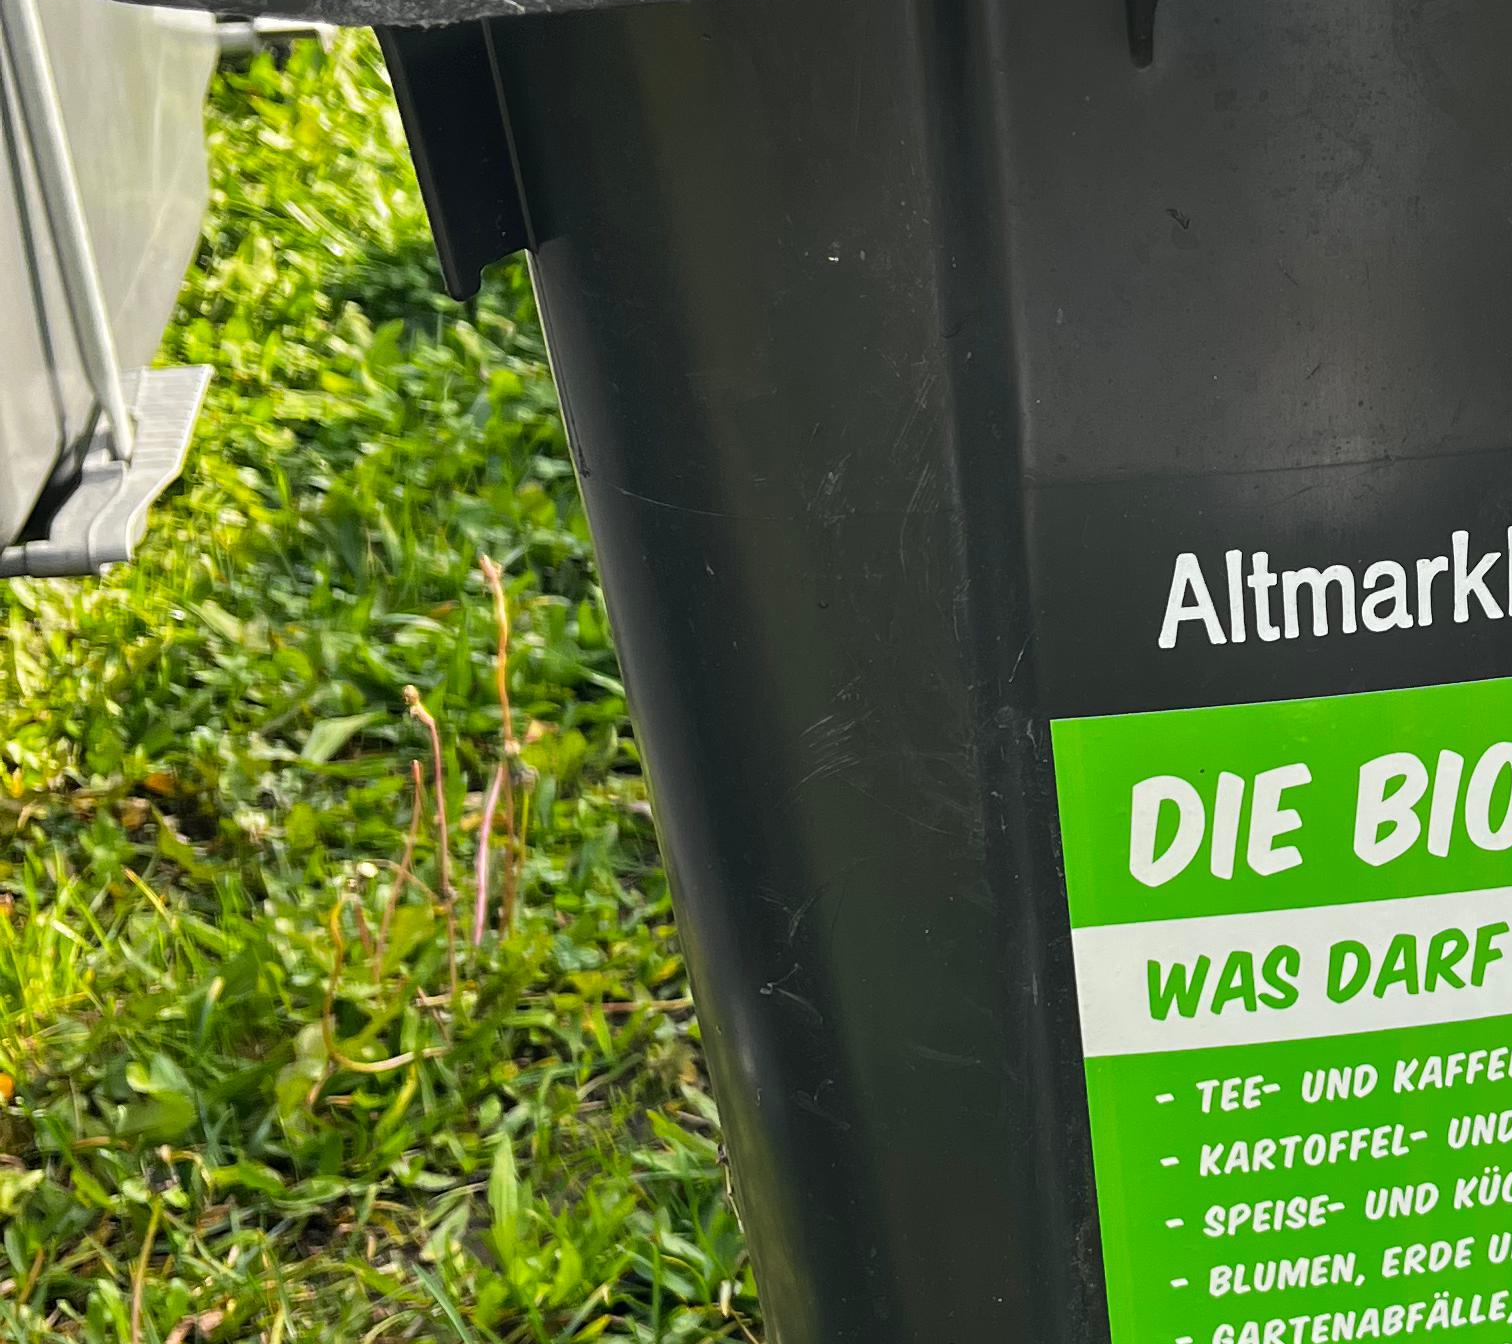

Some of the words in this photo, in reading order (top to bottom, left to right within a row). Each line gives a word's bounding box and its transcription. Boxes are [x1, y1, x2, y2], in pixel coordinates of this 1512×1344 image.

[1130, 763, 1312, 887] DIE
[1147, 945, 1300, 1021] WAS
[1326, 920, 1505, 998] DARF
[1196, 1076, 1280, 1113] TEE-
[1302, 1064, 1377, 1103] UND
[1200, 1124, 1427, 1176] KARTOFFEL-
[1204, 1195, 1344, 1237] SPEISE-
[1366, 1183, 1438, 1220] UND
[1210, 1253, 1365, 1296] BLUMEN,
[1382, 1237, 1474, 1277] ERDE
